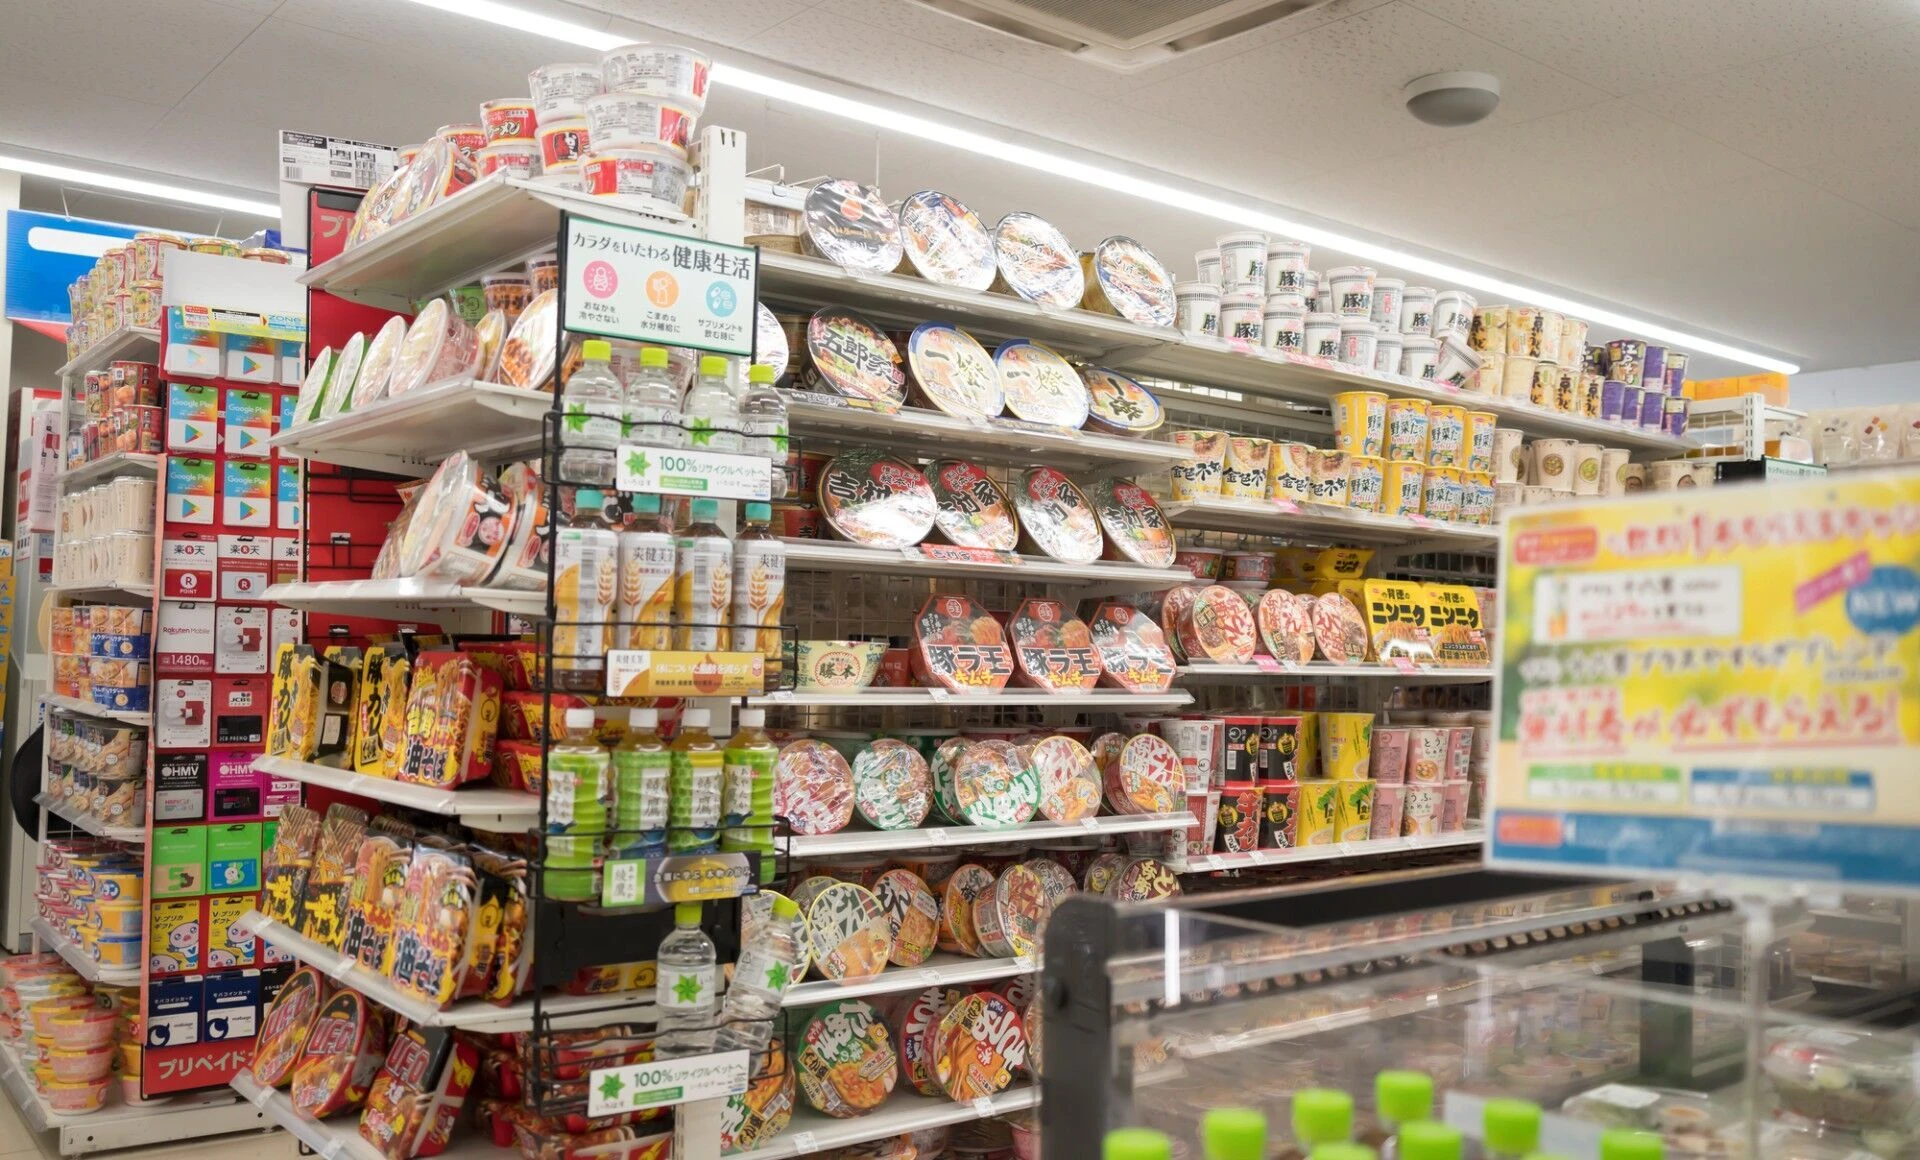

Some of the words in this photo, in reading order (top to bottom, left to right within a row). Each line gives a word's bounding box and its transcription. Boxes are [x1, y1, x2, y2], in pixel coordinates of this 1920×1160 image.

[573, 232, 751, 280] カラダをいたわる健康生活
[584, 301, 616, 313] おなかを
[579, 310, 620, 324] 冷やさない
[647, 310, 676, 322] こまめな
[641, 321, 681, 334] 水分補給に
[172, 398, 198, 408] Google
[228, 403, 254, 413] Google
[170, 472, 197, 482] Google
[1172, 461, 1221, 481] 金色不如
[228, 475, 253, 484] Google
[1373, 602, 1425, 627] ニンニク
[1430, 605, 1479, 629] ニンニク
[162, 627, 190, 636] Rakuten
[955, 668, 994, 687] キムチ
[1049, 671, 1085, 686] キムチ
[1127, 668, 1161, 684] キムチ
[172, 766, 199, 777] HMV
